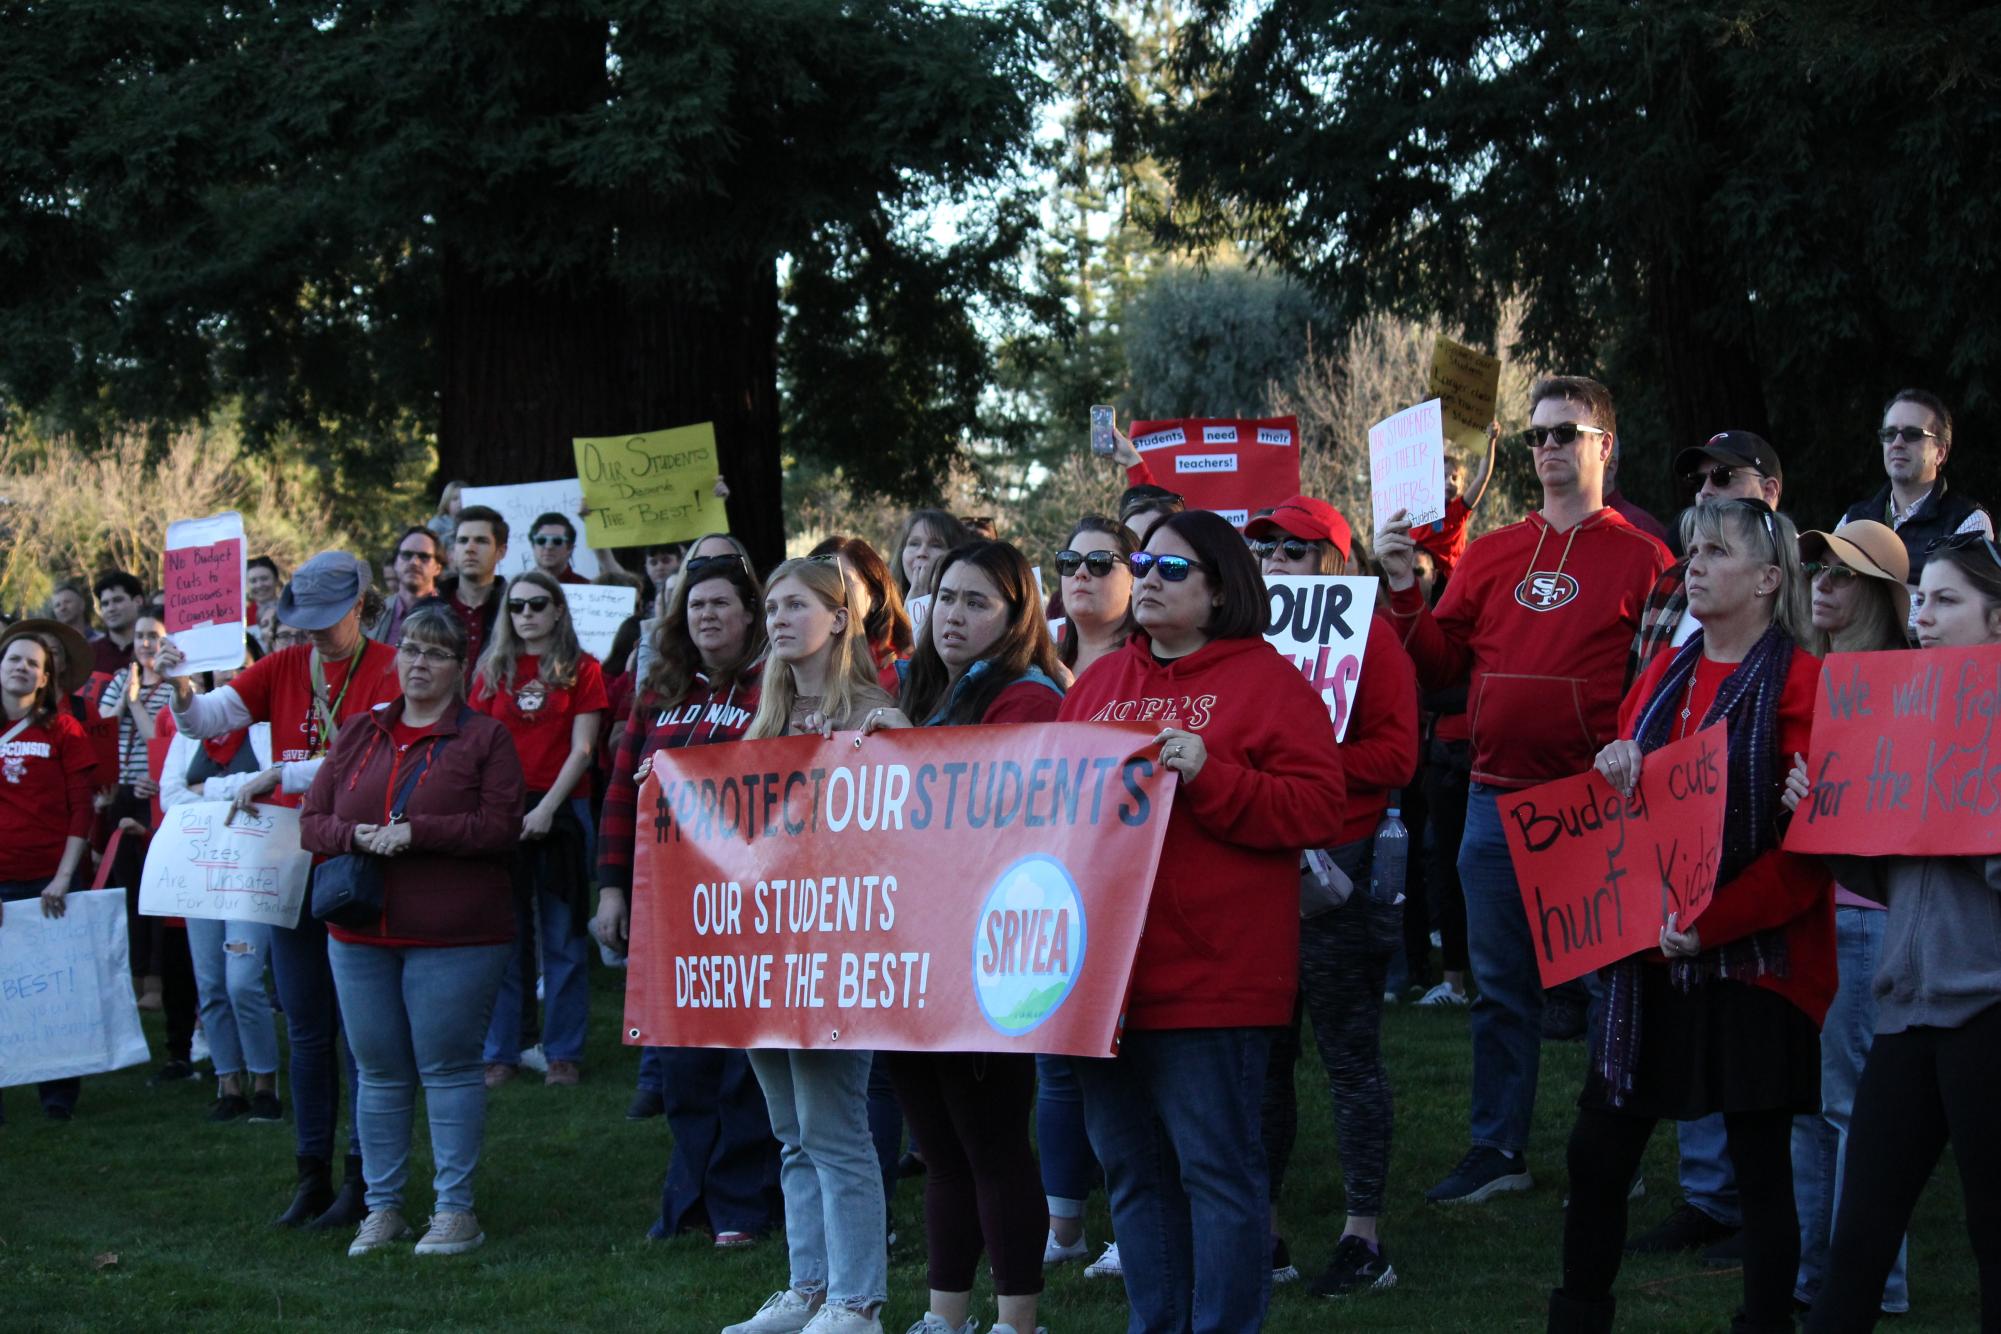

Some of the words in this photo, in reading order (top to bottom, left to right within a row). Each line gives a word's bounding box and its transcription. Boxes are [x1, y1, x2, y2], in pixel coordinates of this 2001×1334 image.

[1132, 431, 1184, 449] students
[1206, 430, 1236, 440] need
[1260, 432, 1289, 443] their
[584, 442, 627, 482] OUR
[625, 437, 710, 477] STUDENTS
[1178, 456, 1233, 469] teachers!
[168, 552, 186, 571] No
[193, 544, 232, 569] Budget
[176, 572, 202, 590] Cuts
[209, 570, 219, 583] to
[170, 588, 223, 608] Classrooms
[1264, 584, 1355, 645] OUR
[1824, 664, 1873, 720] We
[1893, 664, 1943, 722] will
[656, 704, 702, 728] OLD
[704, 703, 750, 729] NAVY
[1669, 740, 1720, 801] cuts
[1807, 751, 1852, 824] for
[1865, 735, 1913, 813] the
[654, 757, 1154, 845] #PROTECTOURSTUDENTS
[180, 808, 212, 843] Big
[232, 811, 276, 829] lass
[188, 839, 241, 861] Sizes
[156, 866, 188, 889] Are
[208, 868, 274, 892] Unsafe
[176, 892, 204, 910] For
[213, 894, 240, 910] Our
[693, 880, 742, 936] OUR
[754, 875, 898, 935] STUDENTS
[1535, 853, 1627, 963] hurt
[982, 908, 1069, 976] SRVEA
[2, 967, 75, 1001] BEST!
[675, 953, 774, 1009] DESERVE
[784, 952, 828, 1008] THE
[837, 952, 930, 1008] BEST!
